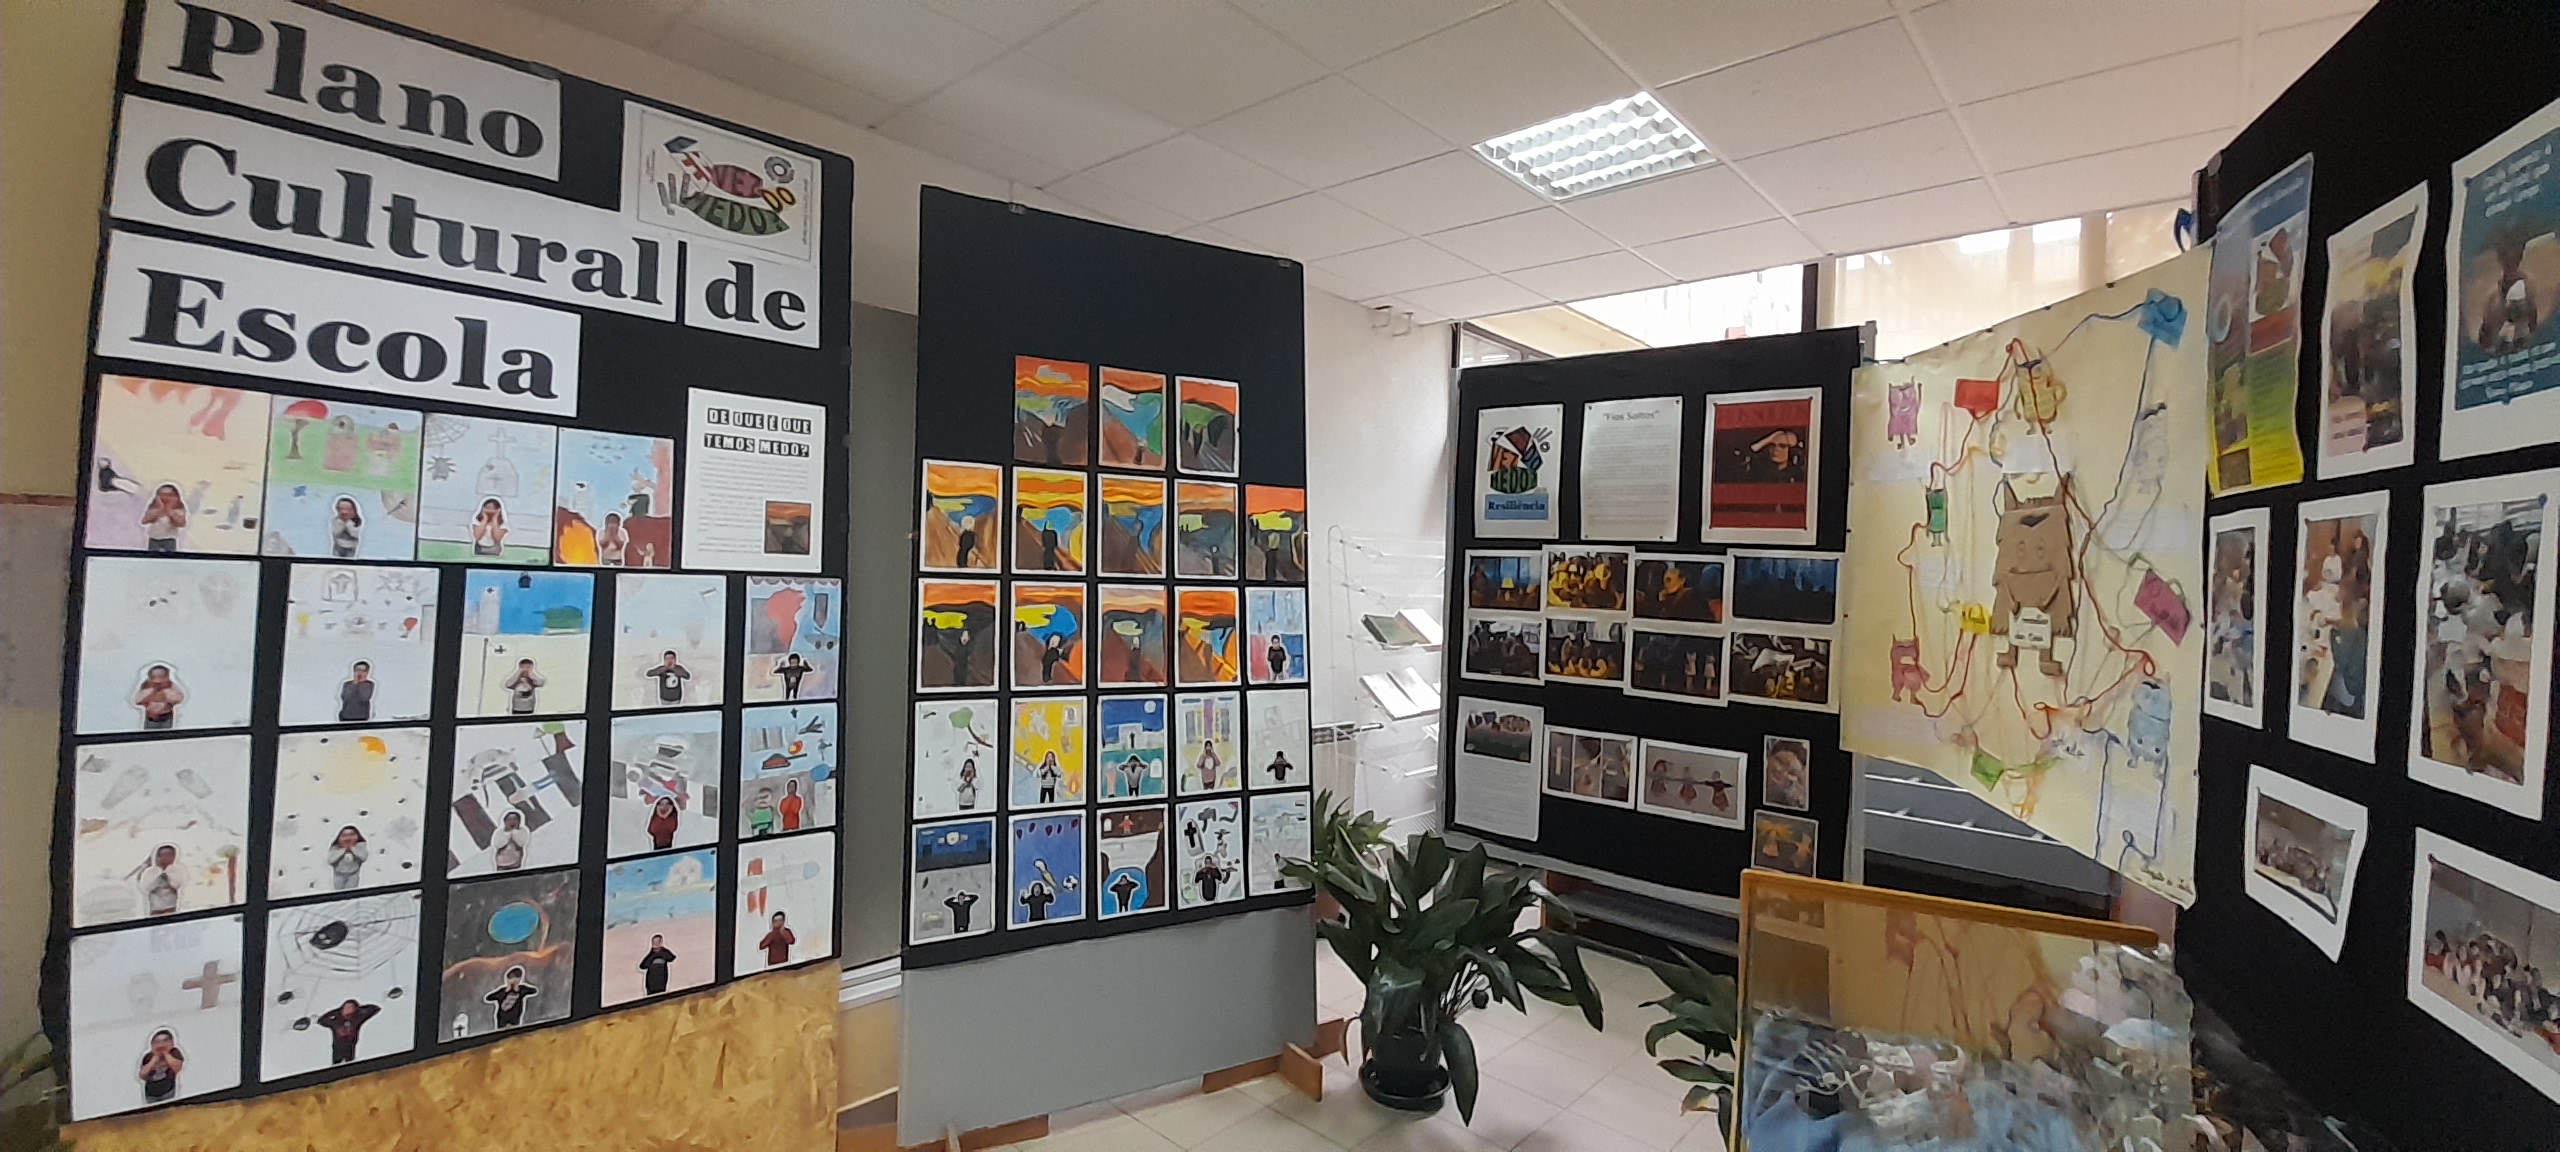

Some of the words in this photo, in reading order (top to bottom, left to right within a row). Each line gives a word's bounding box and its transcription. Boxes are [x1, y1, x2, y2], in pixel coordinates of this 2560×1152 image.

[165, 0, 544, 159] Plano
[144, 137, 663, 306] Cultural
[705, 259, 806, 332] de
[130, 267, 559, 399] Escola
[704, 433, 756, 453] TEMOS
[759, 439, 810, 458] MEDO?
[707, 408, 730, 426] DE
[733, 411, 765, 430] QUE
[767, 415, 779, 432] É
[781, 417, 812, 435] QUE
